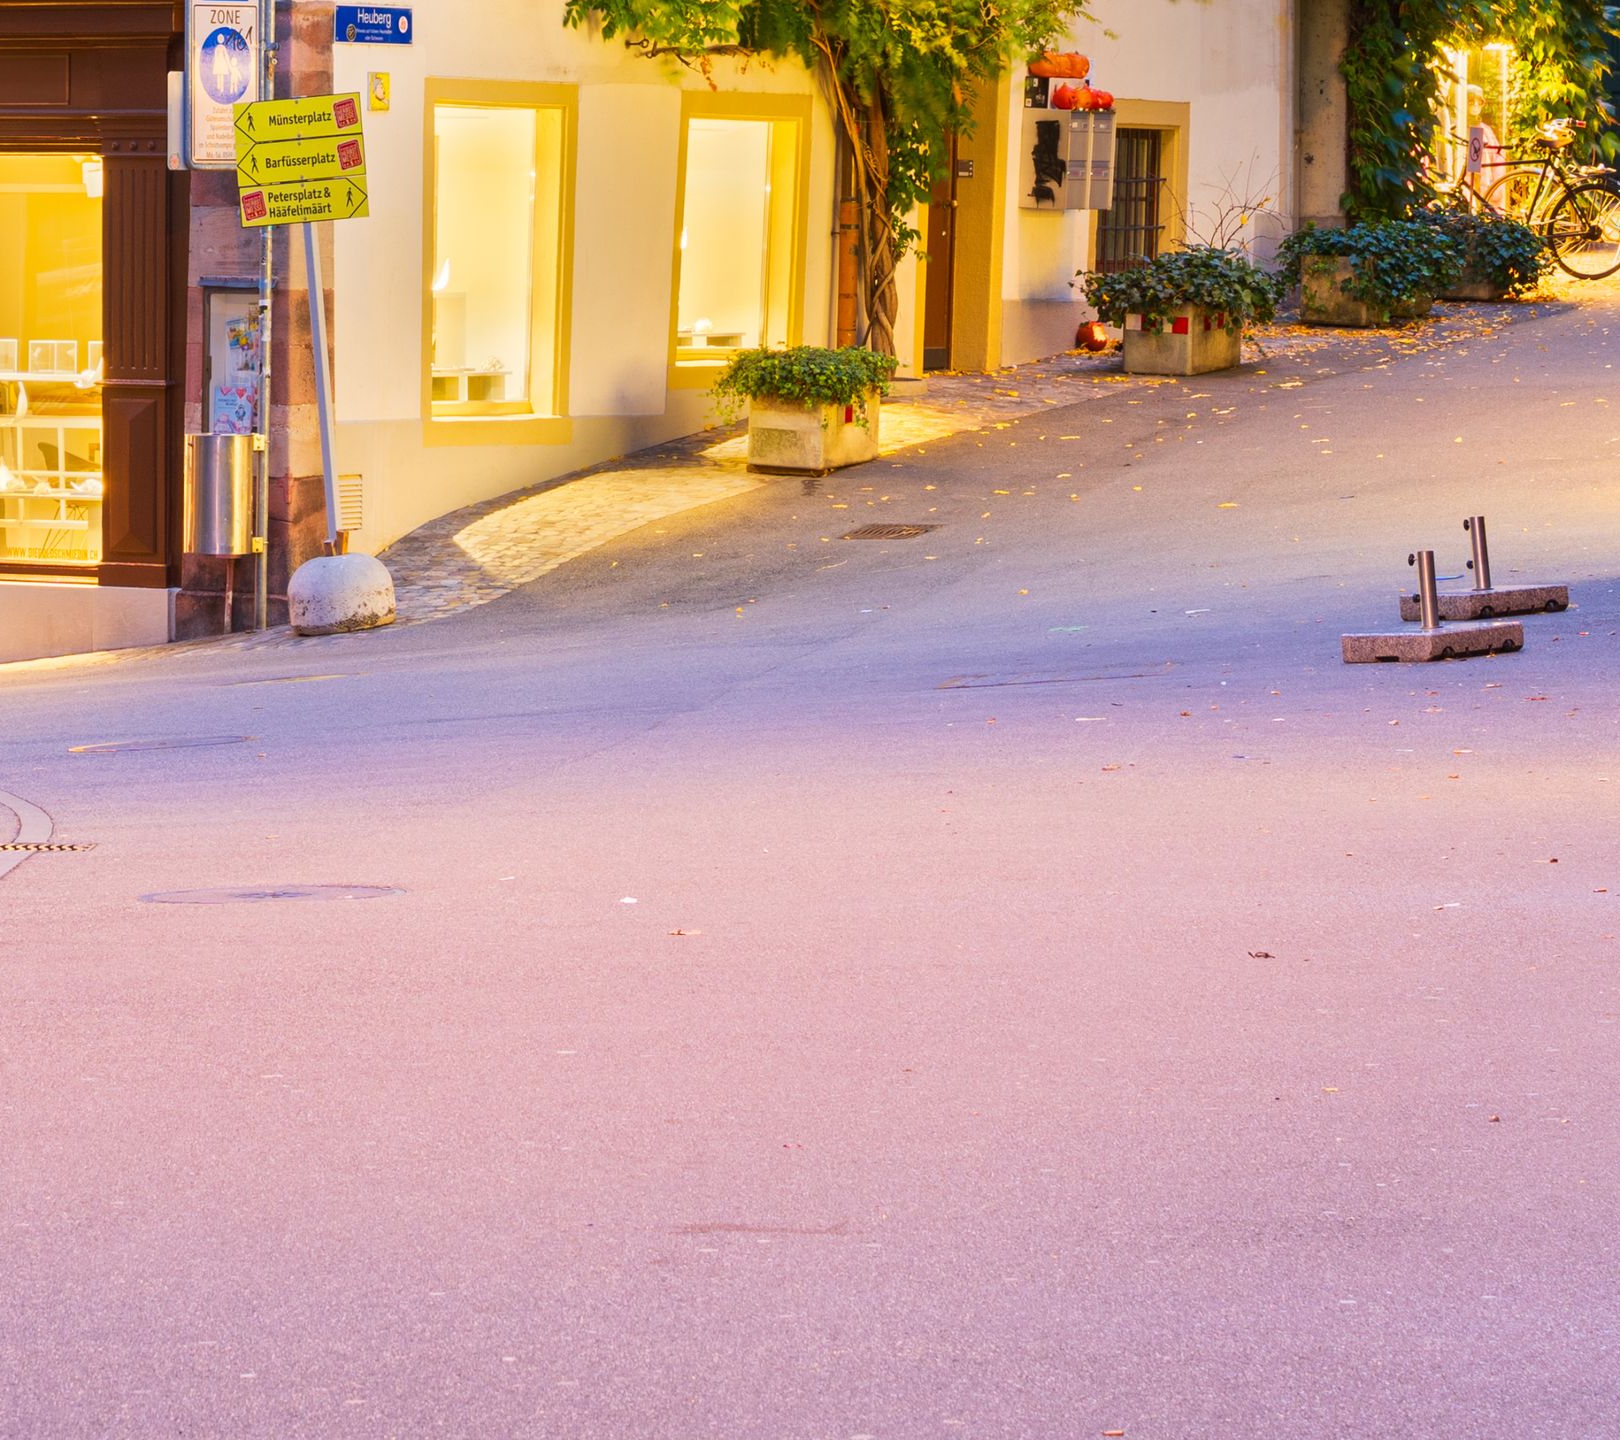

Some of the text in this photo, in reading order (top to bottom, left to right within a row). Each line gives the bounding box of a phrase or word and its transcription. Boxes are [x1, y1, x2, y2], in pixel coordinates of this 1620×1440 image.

[210, 9, 240, 25] ZONE
[357, 8, 392, 29] Heuberg
[268, 111, 332, 126] Münsterplatz
[265, 153, 335, 168] Barfüsserplatz
[268, 186, 331, 203] Petersplatz &
[269, 203, 332, 219] Hääfelimäärt
